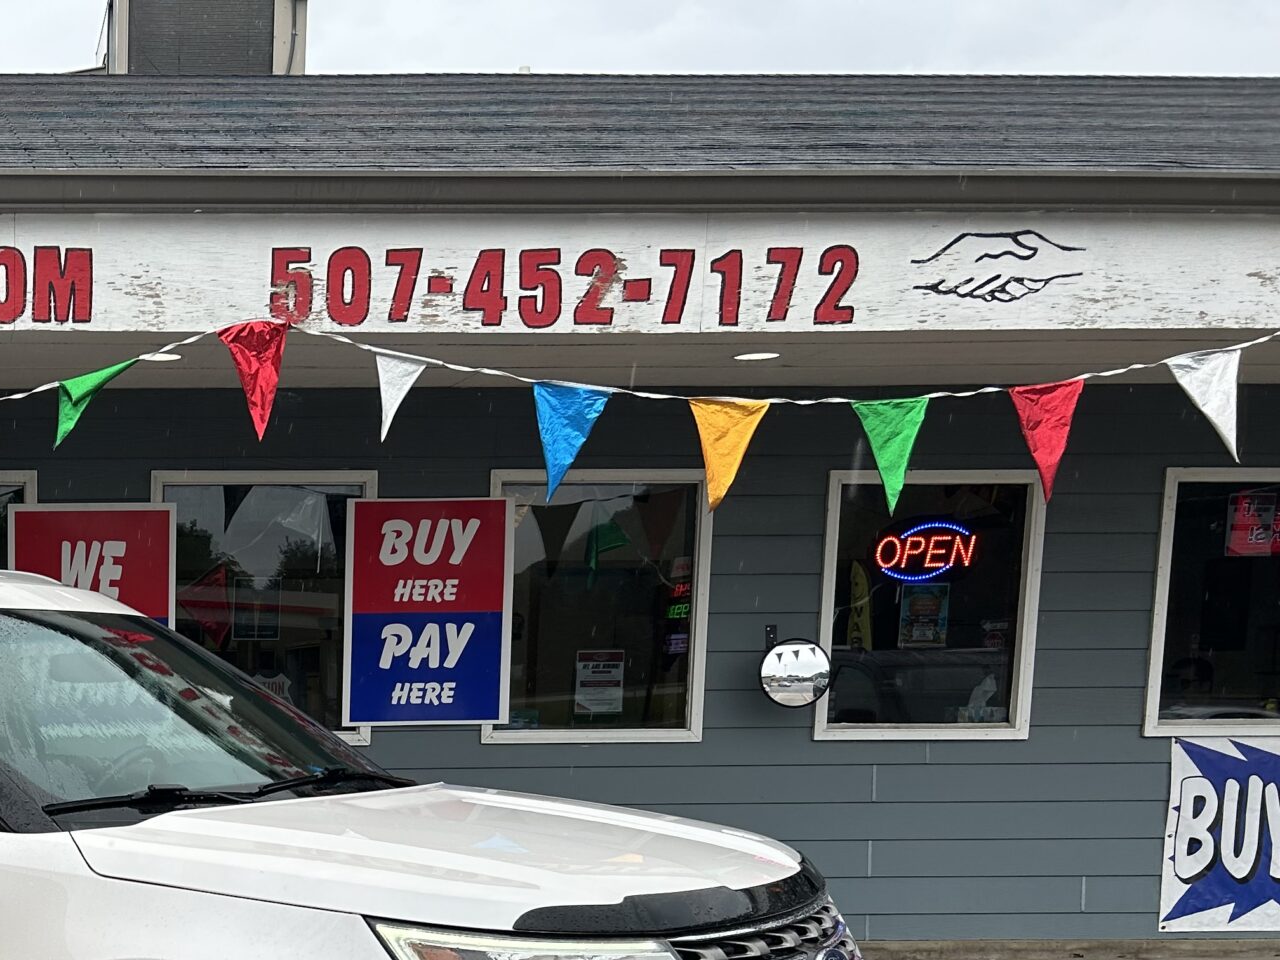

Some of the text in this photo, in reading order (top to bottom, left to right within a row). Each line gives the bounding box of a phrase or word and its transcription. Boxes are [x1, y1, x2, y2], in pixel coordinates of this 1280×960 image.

[270, 246, 859, 329] 507-452-7172
[379, 519, 480, 565] BUY
[876, 534, 976, 568] OPEN
[61, 540, 126, 600] WE
[394, 579, 459, 603] HERE
[379, 623, 475, 669] PAY
[391, 682, 456, 705] HERE
